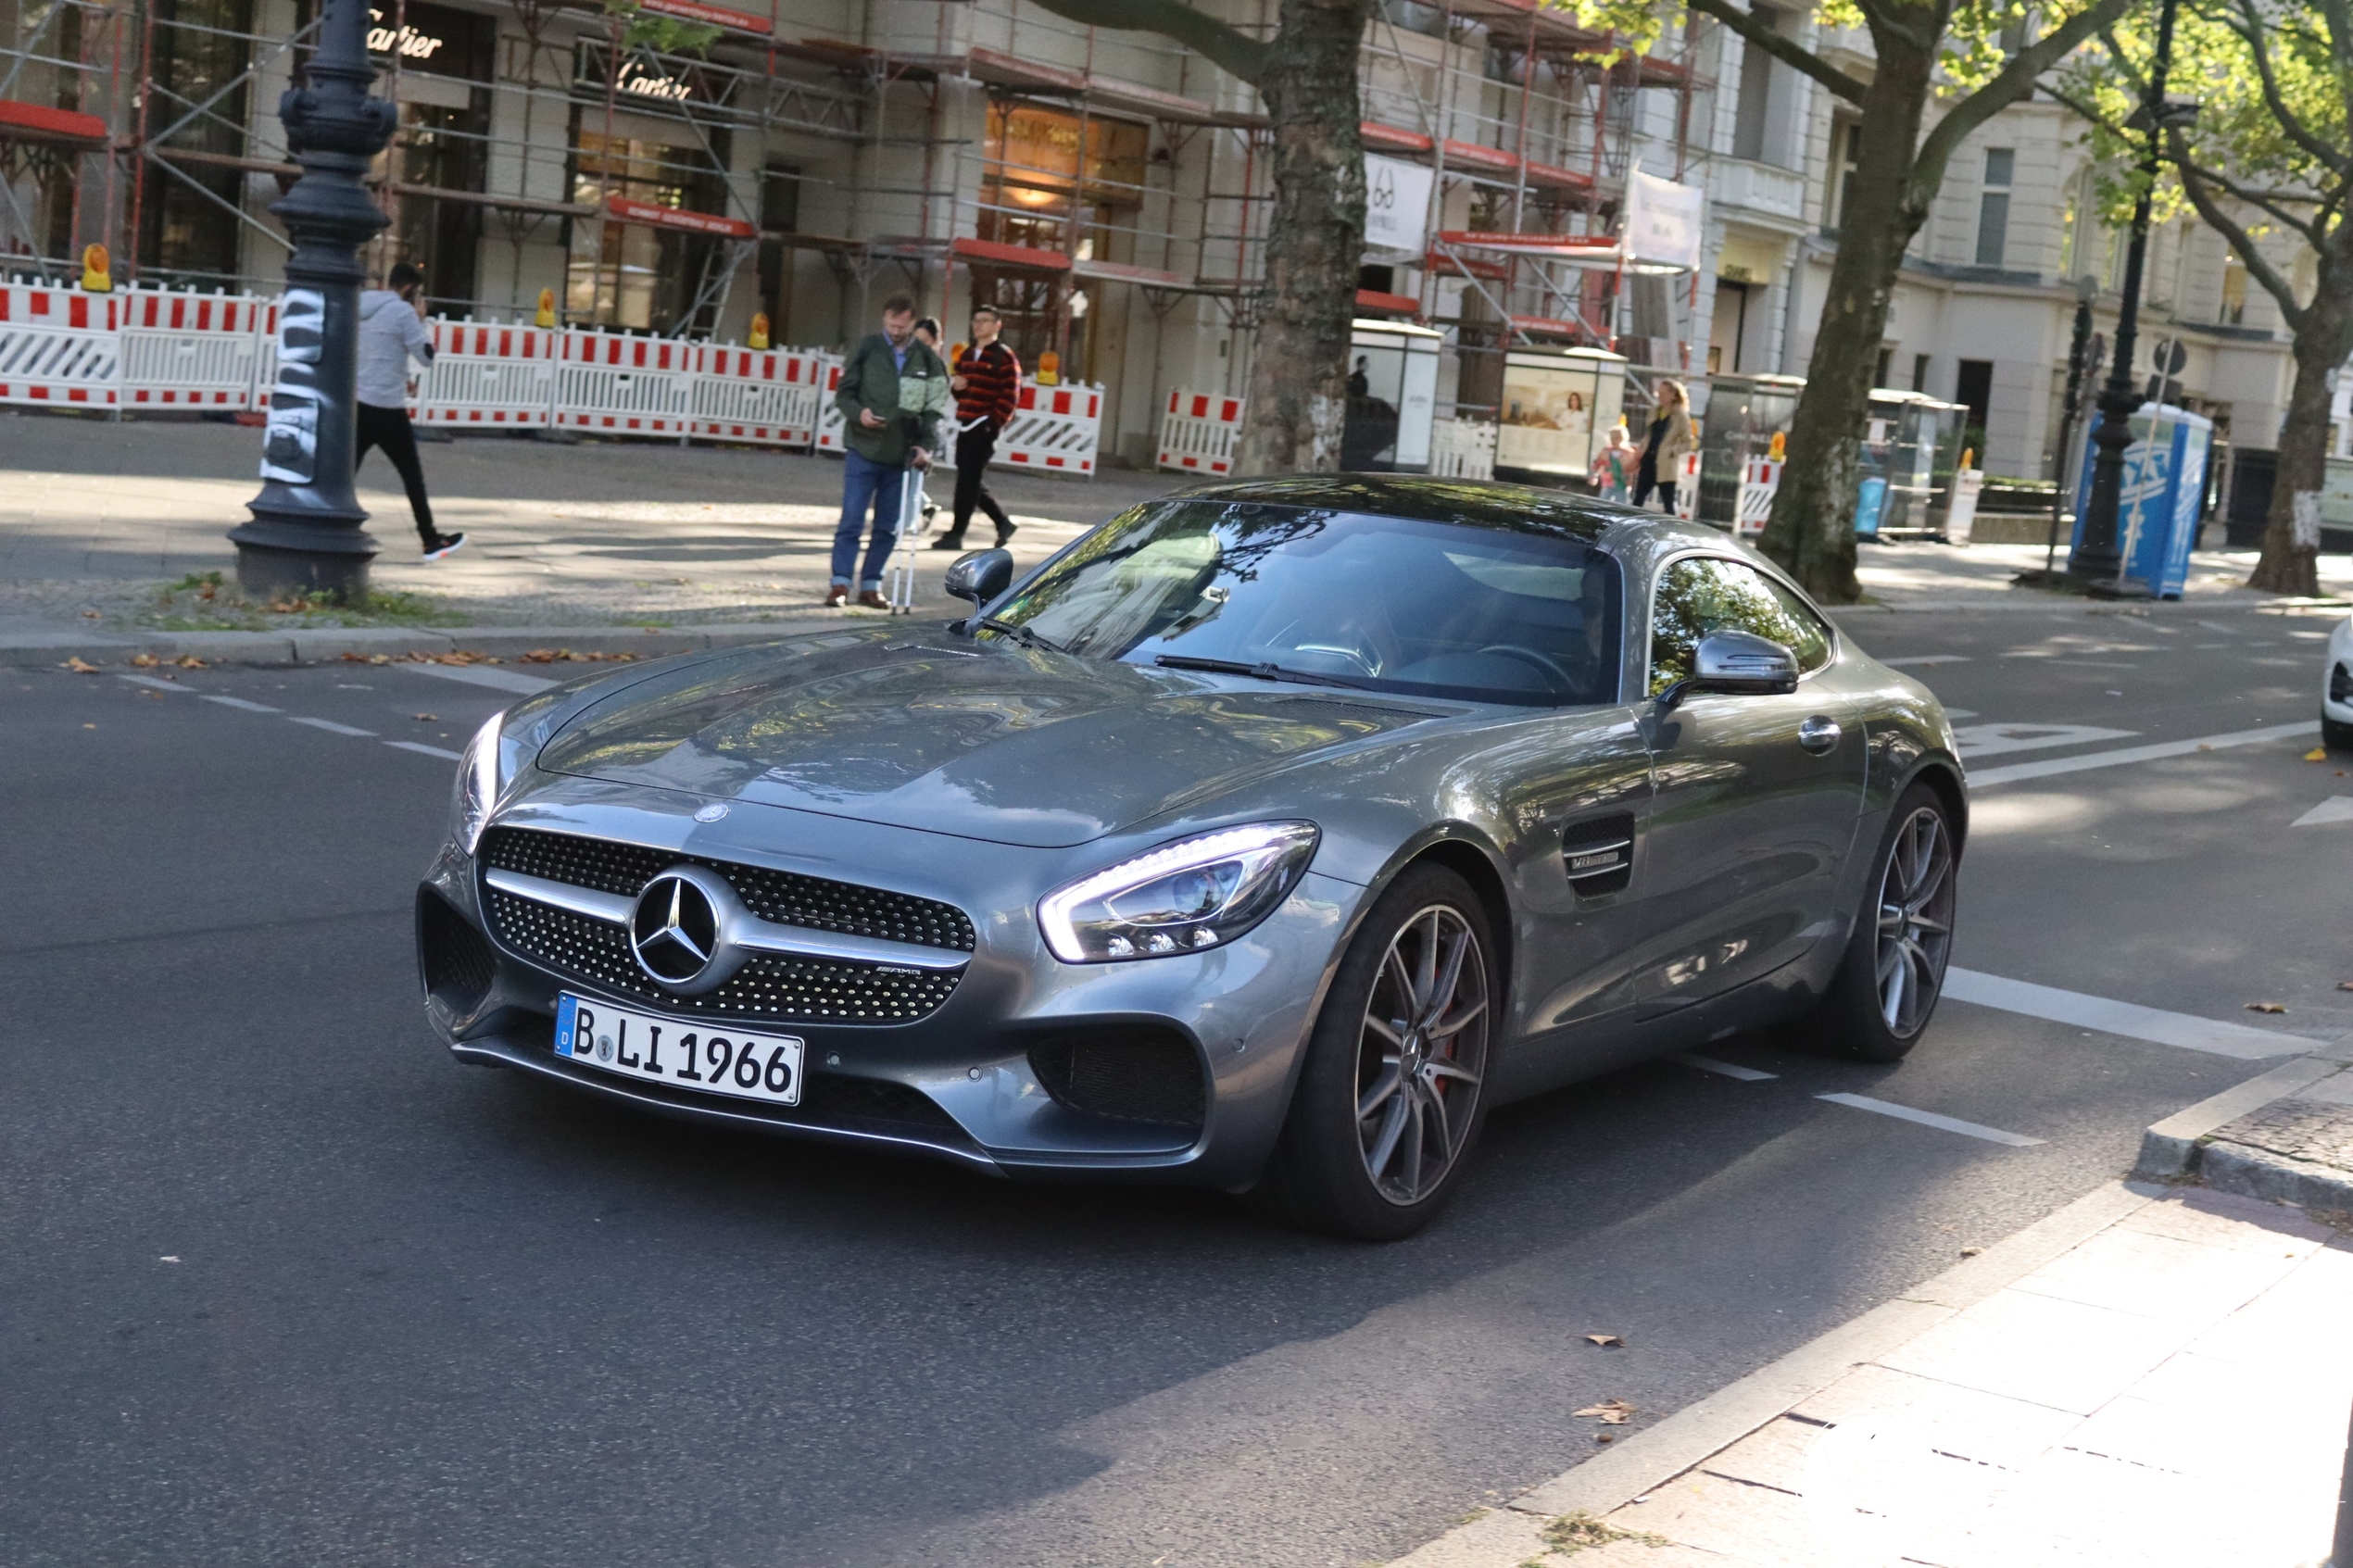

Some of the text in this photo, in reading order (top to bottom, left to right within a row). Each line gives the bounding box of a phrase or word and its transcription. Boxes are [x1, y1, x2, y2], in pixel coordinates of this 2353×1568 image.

[615, 62, 692, 101] Cartier
[889, 967, 922, 976] AMG
[560, 1031, 569, 1046] D
[574, 1007, 792, 1093] B LI 1966
